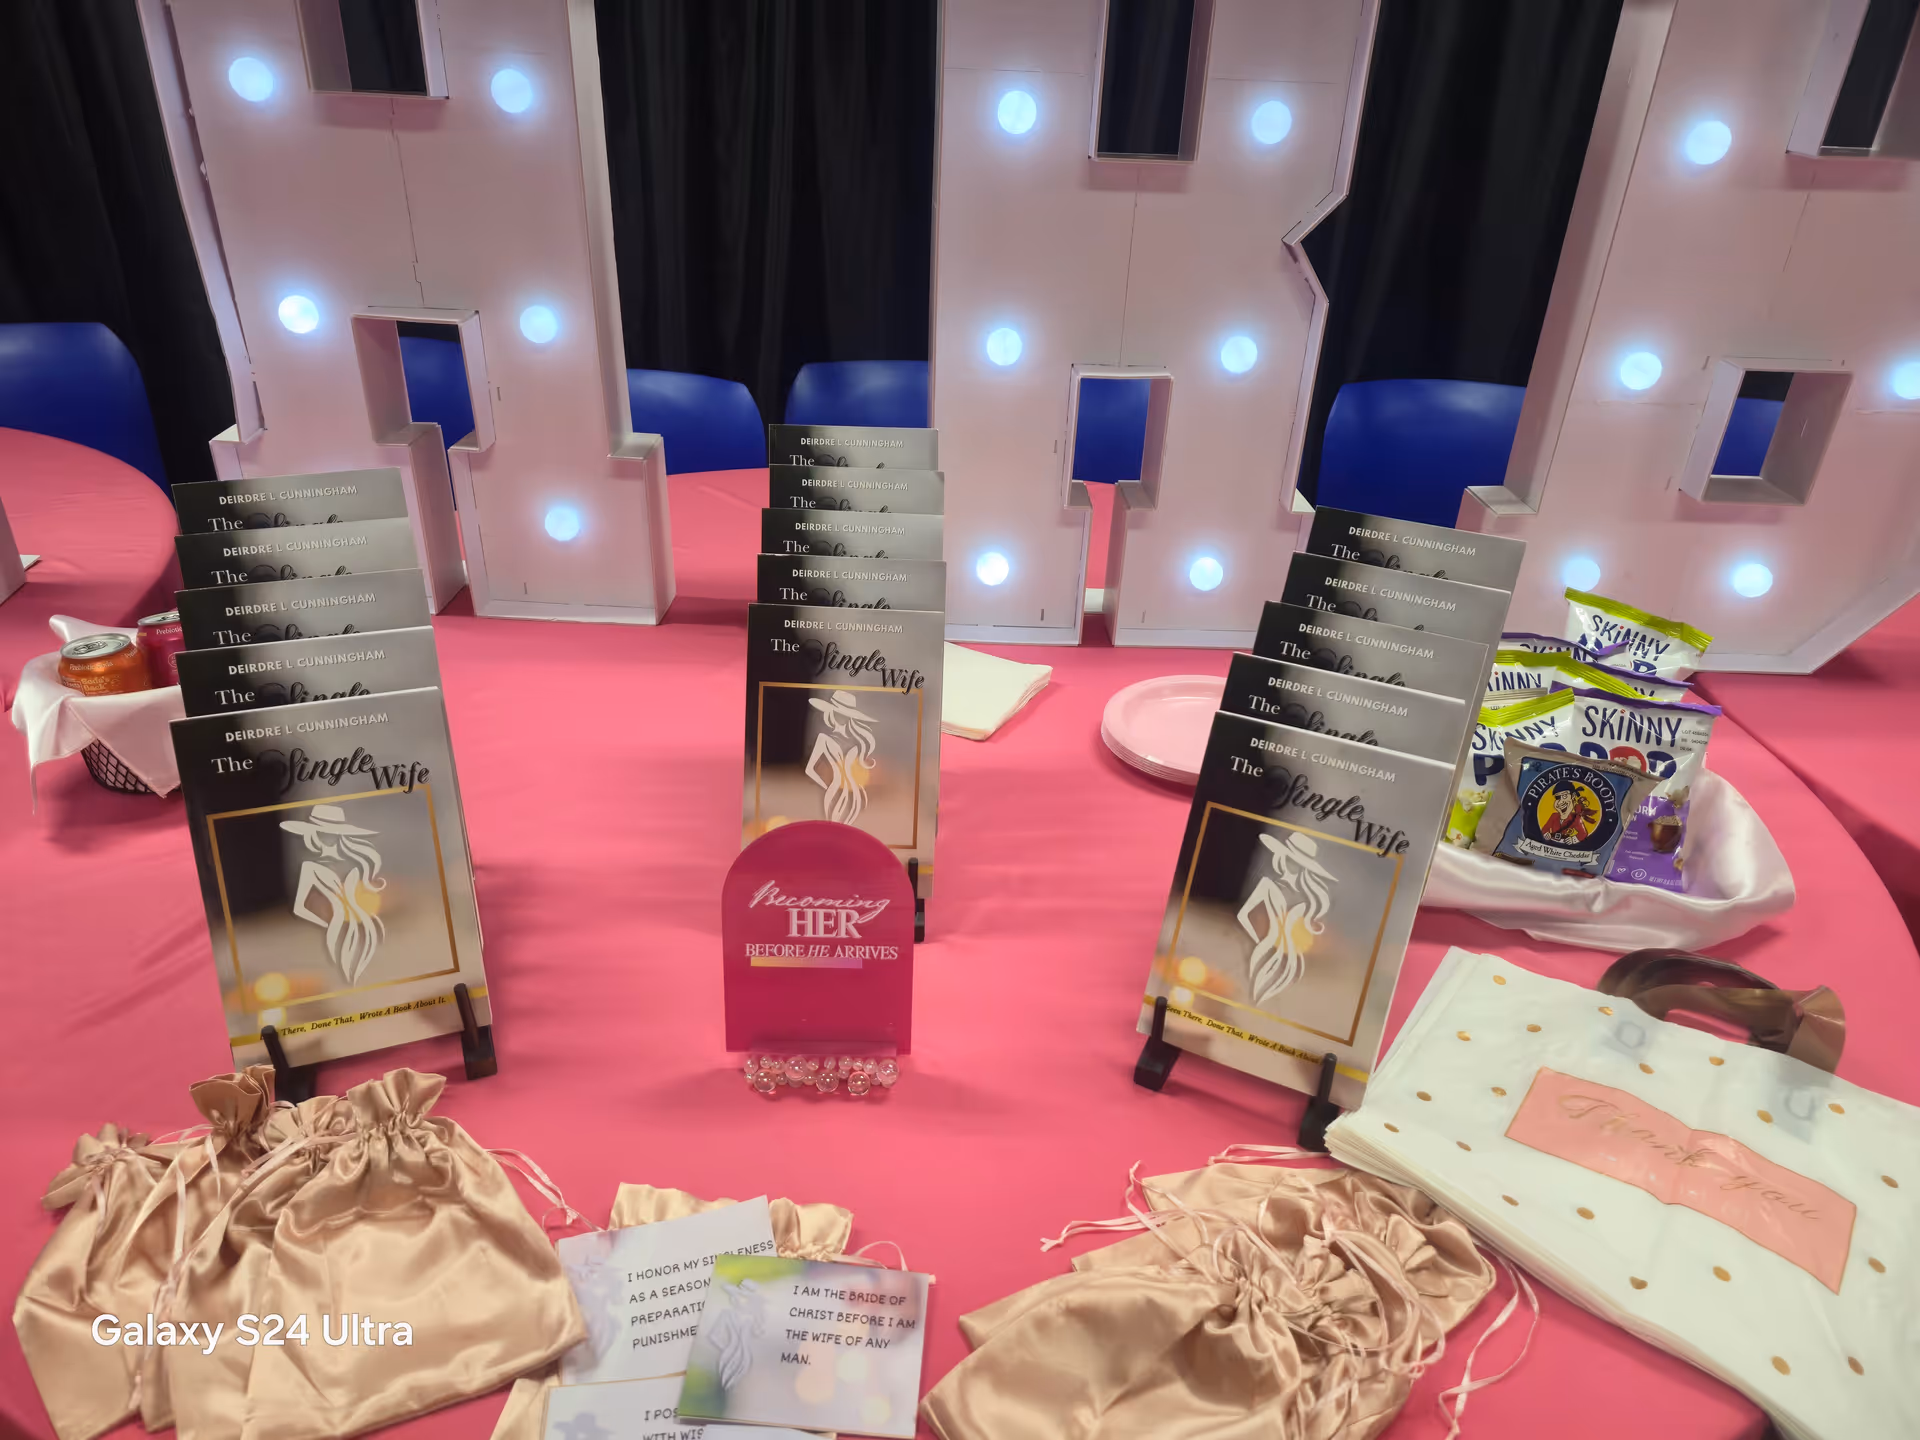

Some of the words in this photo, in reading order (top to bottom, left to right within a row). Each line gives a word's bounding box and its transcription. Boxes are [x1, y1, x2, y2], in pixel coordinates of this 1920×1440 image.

[801, 438, 835, 446] DEIRDRE
[845, 439, 903, 448] CUNNINGHAM
[790, 455, 815, 466] The
[219, 493, 266, 505] DEIRDRE
[280, 485, 358, 500] CUNNINGHAM
[802, 479, 837, 487] DEIRDRE
[848, 480, 908, 491] CUNNINGHAM
[790, 496, 816, 508] The
[208, 518, 243, 532] The
[795, 523, 832, 532] DEIRDRE
[842, 524, 905, 535] CUNNINGHAM
[223, 545, 273, 557] DEIRDRE
[286, 536, 367, 552] CUNNINGHAM
[783, 540, 810, 553] The
[1349, 526, 1391, 541] DEIRDRE
[1402, 536, 1476, 556] CUNNINGHAM
[1331, 543, 1361, 561] The
[211, 570, 248, 584] The
[792, 569, 831, 579] DEIRDRE
[842, 571, 908, 582] CUNNINGHAM
[779, 587, 808, 600] The
[1306, 593, 1337, 613] The
[1325, 576, 1368, 593] DEIRDRE
[1380, 588, 1456, 612] CUNNINGHAM
[226, 603, 277, 616] DEIRDRE
[291, 593, 376, 610] CUNNINGHAM
[784, 619, 824, 629] DEIRDRE
[835, 622, 903, 633] CUNNINGHAM
[213, 631, 252, 645] The
[1299, 623, 1344, 640] DEIRDRE
[1355, 635, 1434, 658] CUNNINGHAM
[1280, 640, 1311, 660] The
[228, 660, 282, 675] DEIRDRE
[297, 650, 386, 667] CUNNINGHAM
[771, 638, 800, 652] The
[802, 639, 887, 677] Single
[881, 668, 925, 695] Wife
[215, 690, 255, 706] The
[1249, 694, 1281, 715] The
[1268, 676, 1314, 695] DEIRDRE
[1326, 690, 1408, 717] CUNNINGHAM
[225, 726, 281, 742] DEIRDRE
[296, 713, 389, 733] CUNNINGHAM
[1250, 737, 1298, 757] DEIRDRE
[1311, 753, 1396, 783] CUNNINGHAM
[211, 757, 253, 774] The
[257, 747, 375, 795] Single
[371, 761, 430, 794] Wife
[1527, 766, 1582, 799] PIRATE'S
[1583, 771, 1617, 813] BOOTY
[1230, 755, 1264, 778] The
[1266, 765, 1365, 822] Single
[1351, 818, 1411, 857] Wife
[1525, 839, 1543, 852] Aged
[1542, 844, 1563, 857] White
[1562, 848, 1590, 859] Cheddar
[748, 880, 890, 924] Becoming
[787, 908, 863, 939] HER
[745, 943, 805, 958] BEFORE
[807, 944, 830, 958] HE
[833, 945, 899, 961] ARRIVES
[281, 1025, 307, 1036] There,
[311, 1020, 332, 1030] Done
[334, 1015, 355, 1025] That,
[359, 1010, 383, 1020] Wrote
[394, 1002, 412, 1013] Book
[413, 999, 436, 1010] About
[1206, 1019, 1225, 1031] Done
[1247, 1034, 1270, 1047] Wrote
[1719, 1175, 1821, 1220] you
[628, 1273, 633, 1282] I
[636, 1263, 680, 1281] HONOR
[683, 1258, 700, 1271] MY
[629, 1292, 646, 1304] AS
[649, 1290, 658, 1300] A
[662, 1277, 711, 1297] SEASON
[793, 1285, 799, 1295] I
[801, 1286, 820, 1297] AM
[824, 1288, 846, 1300] THE
[849, 1291, 886, 1304] BRIDE
[889, 1295, 906, 1305] OF
[789, 1307, 834, 1321] CHRIST
[836, 1312, 885, 1326] BEFORE
[888, 1317, 894, 1327] I
[896, 1318, 915, 1329] AM
[785, 1329, 808, 1341] THE
[811, 1331, 842, 1345] WIFE
[845, 1335, 863, 1346] OF
[865, 1338, 891, 1349] ANY
[780, 1352, 811, 1365] MAN.
[644, 1410, 650, 1420] I
